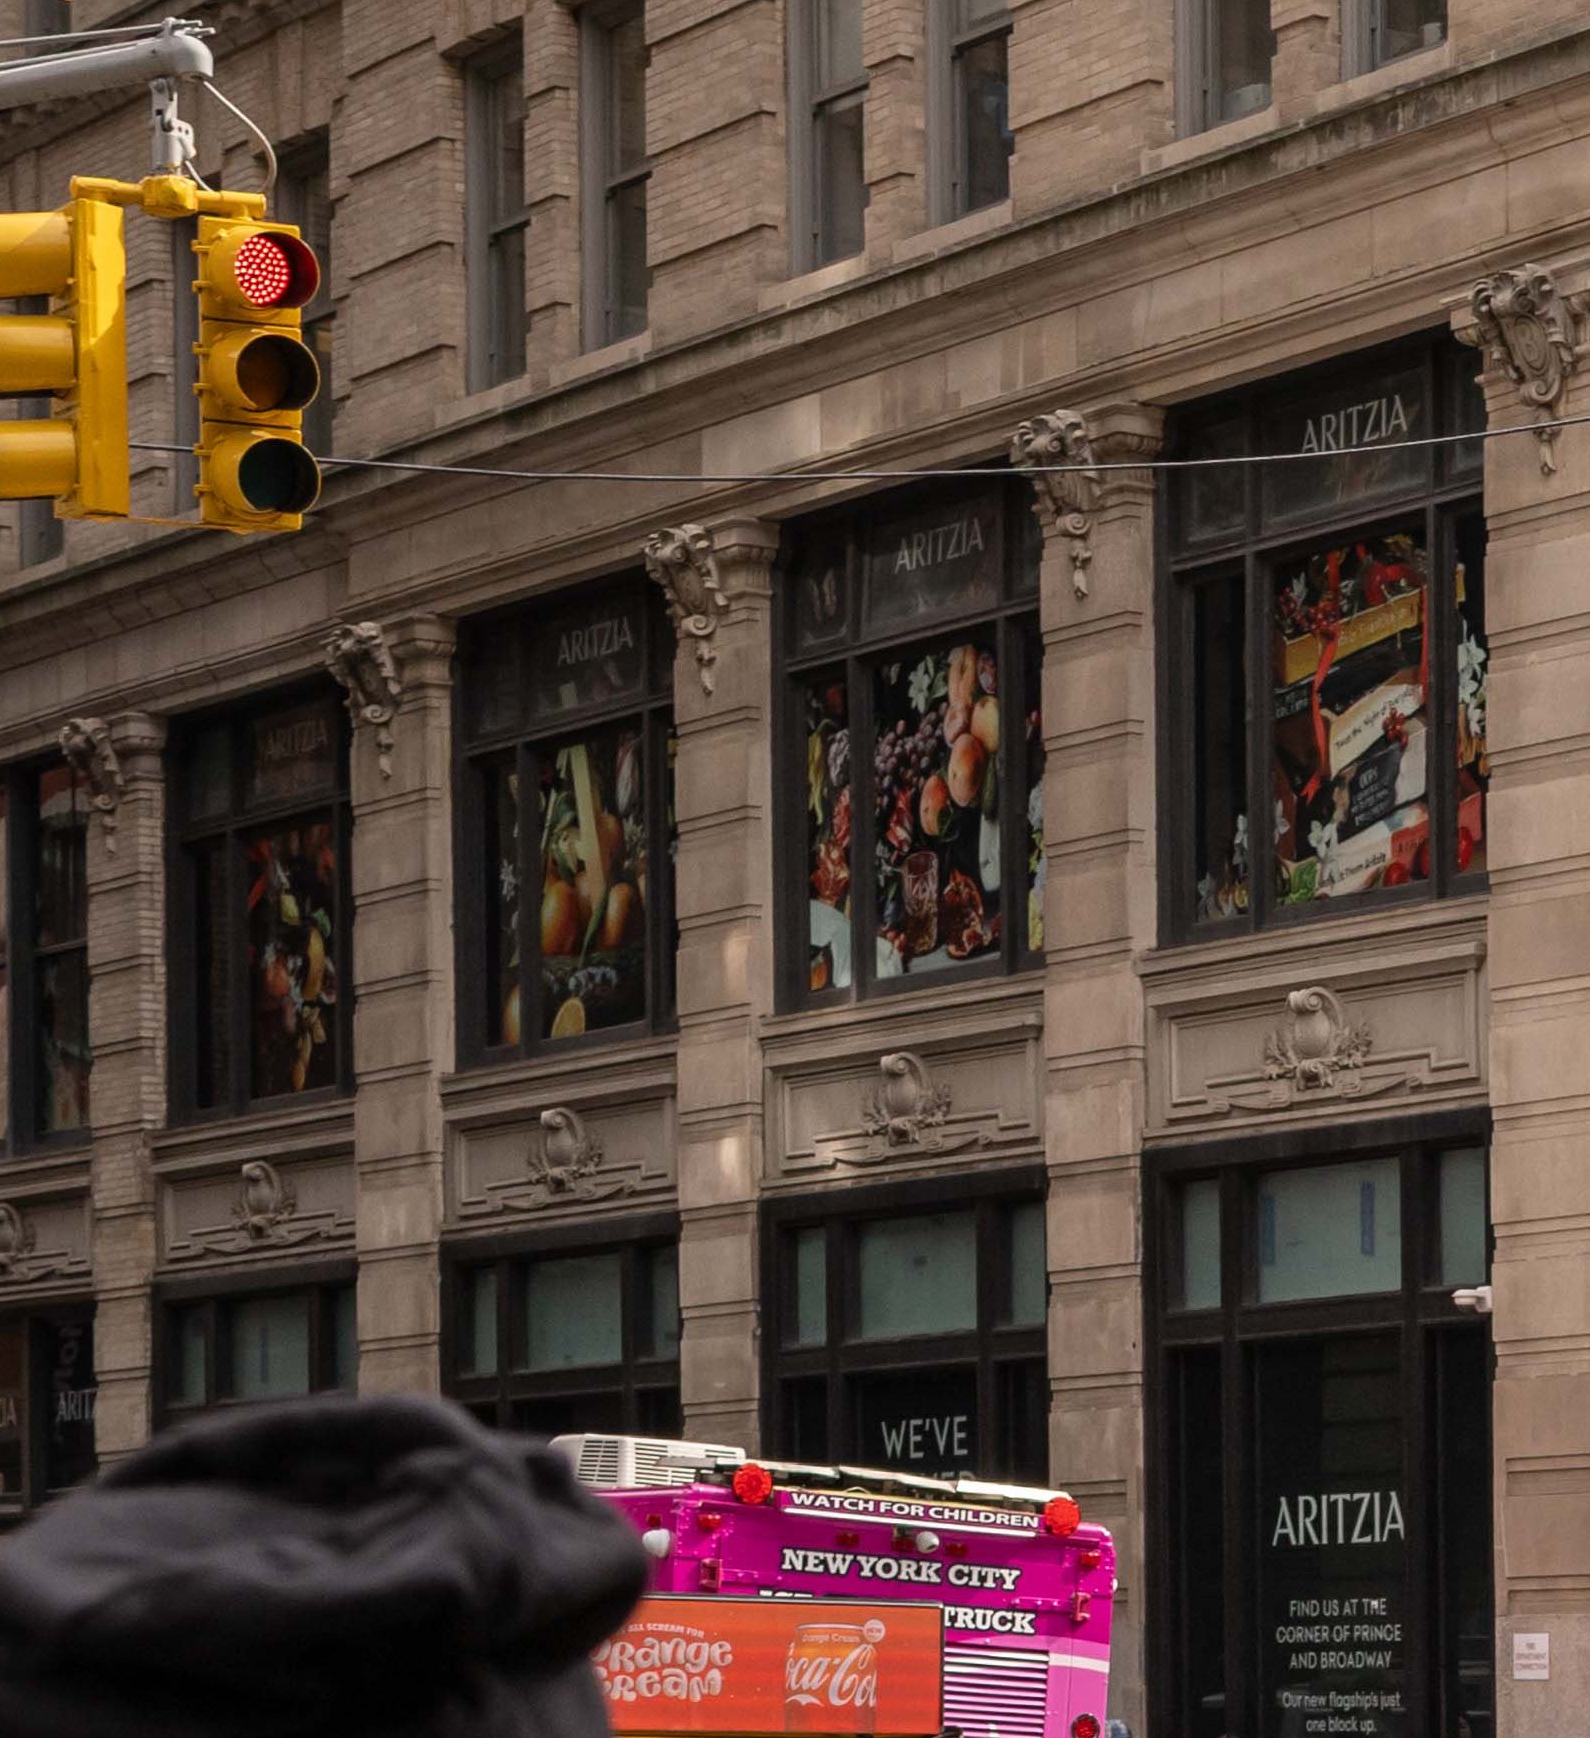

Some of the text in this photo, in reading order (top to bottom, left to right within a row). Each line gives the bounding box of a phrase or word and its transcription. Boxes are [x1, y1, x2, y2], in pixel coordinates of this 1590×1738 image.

[1302, 394, 1408, 453] ARITZIA
[895, 518, 985, 574] ARITZIA
[557, 617, 632, 665] ARITZIA
[55, 1390, 96, 1425] ARIT
[880, 1415, 968, 1460] WE'VE
[791, 1493, 1039, 1529] WATCH FOR CHILDREN
[1272, 1491, 1405, 1547] ARITZIA
[781, 1548, 1021, 1591] NEW YORK CITY
[944, 1605, 1036, 1634] TRUCK
[1290, 1598, 1387, 1617] FIND US AT THE
[646, 1623, 684, 1634] SCREAM
[686, 1627, 705, 1639] FOR
[1276, 1624, 1402, 1643] CORNER OF PRINCE
[1290, 1651, 1392, 1669] AND BROADWAY
[1282, 1691, 1303, 1708] Our
[1305, 1695, 1327, 1707] new
[1380, 1690, 1402, 1711] just
[1306, 1716, 1377, 1736] one block up.
